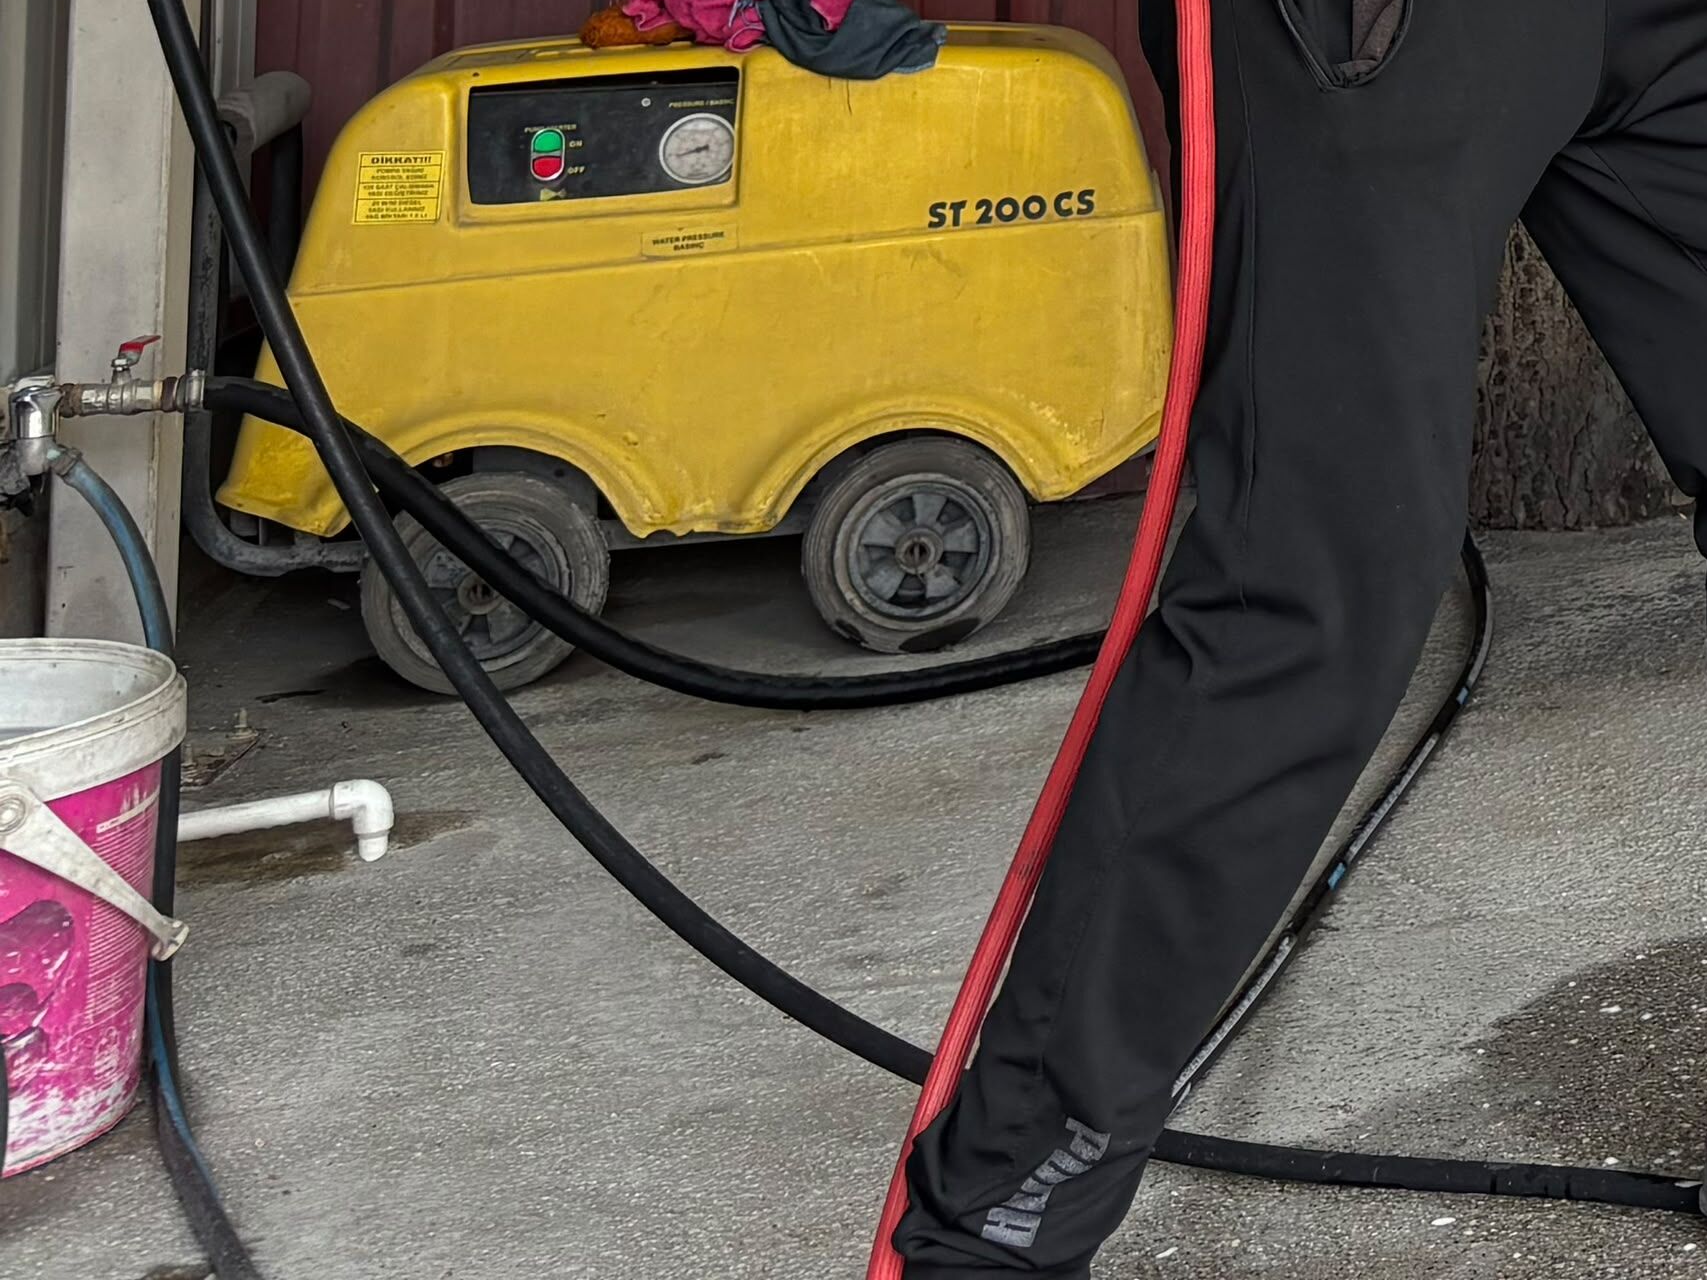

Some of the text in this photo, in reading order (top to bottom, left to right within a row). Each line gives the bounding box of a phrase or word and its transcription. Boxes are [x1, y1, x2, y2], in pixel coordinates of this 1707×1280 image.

[927, 188, 1097, 229] ST 200 CS
